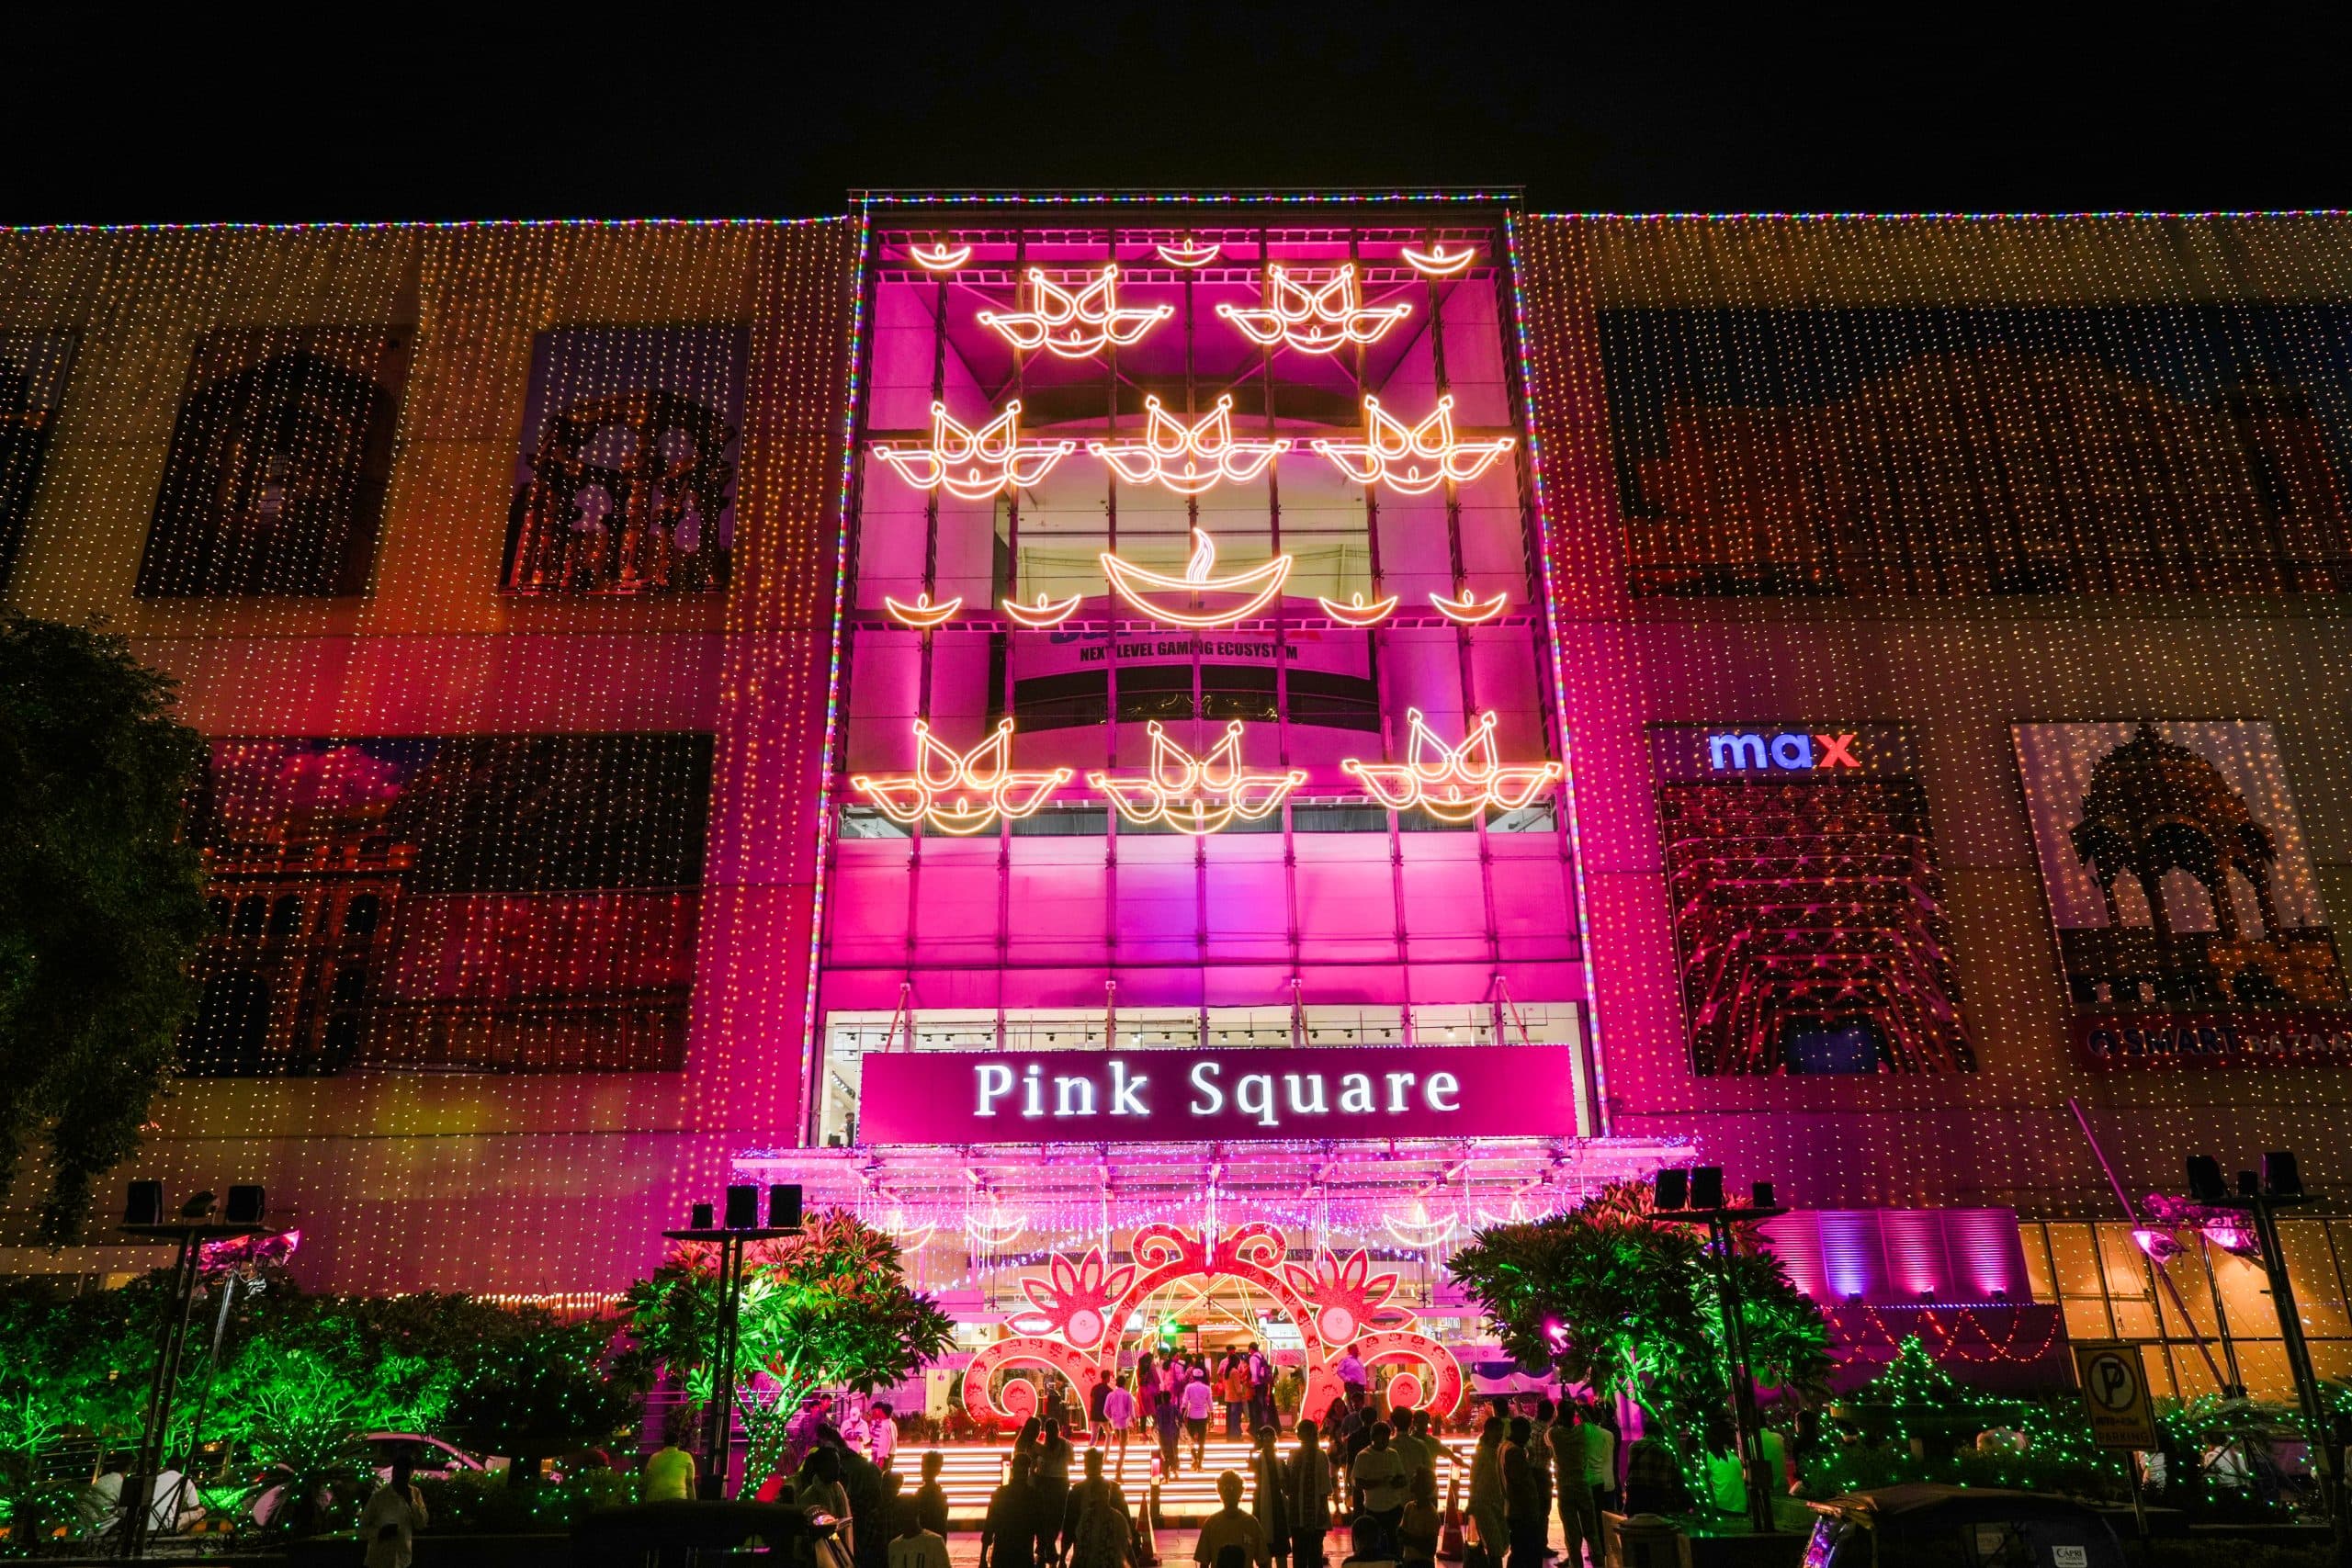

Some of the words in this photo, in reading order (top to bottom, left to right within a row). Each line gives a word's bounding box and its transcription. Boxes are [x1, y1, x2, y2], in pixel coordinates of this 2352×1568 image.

[1116, 642, 1154, 659] LEVEL
[1217, 641, 1298, 660] ECOSYSTM
[1709, 733, 1861, 771] max
[2120, 1027, 2239, 1056] SMART
[2248, 1032, 2351, 1054] BAZAA
[973, 1060, 1151, 1117] Pink
[1191, 1061, 1462, 1126] Square
[2057, 1548, 2082, 1558] CAPRI
